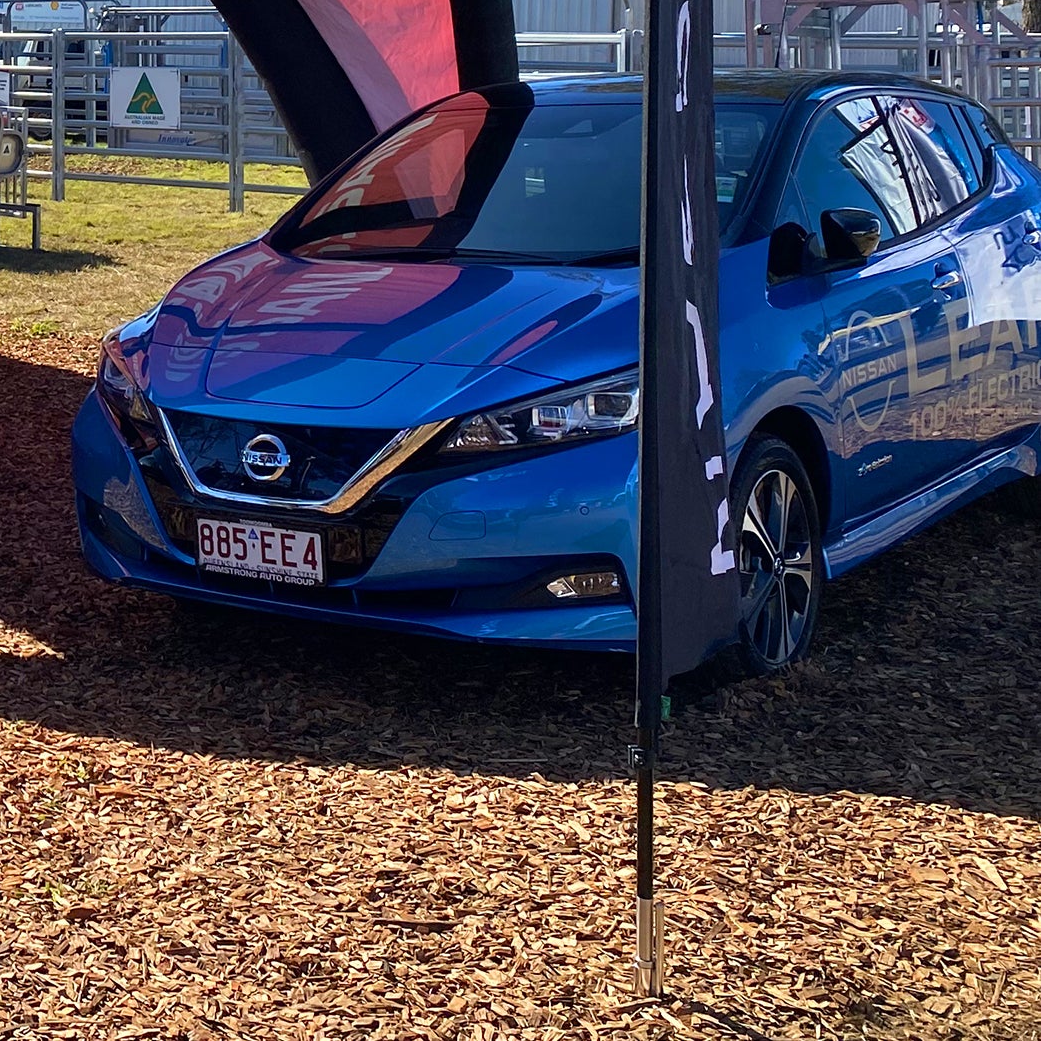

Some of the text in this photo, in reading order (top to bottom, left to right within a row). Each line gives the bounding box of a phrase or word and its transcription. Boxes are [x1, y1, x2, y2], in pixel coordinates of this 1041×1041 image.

[842, 355, 898, 389] NISSAN
[242, 451, 283, 465] NISSAN
[205, 564, 315, 586] ARMSTRONG AUTO GROUP
